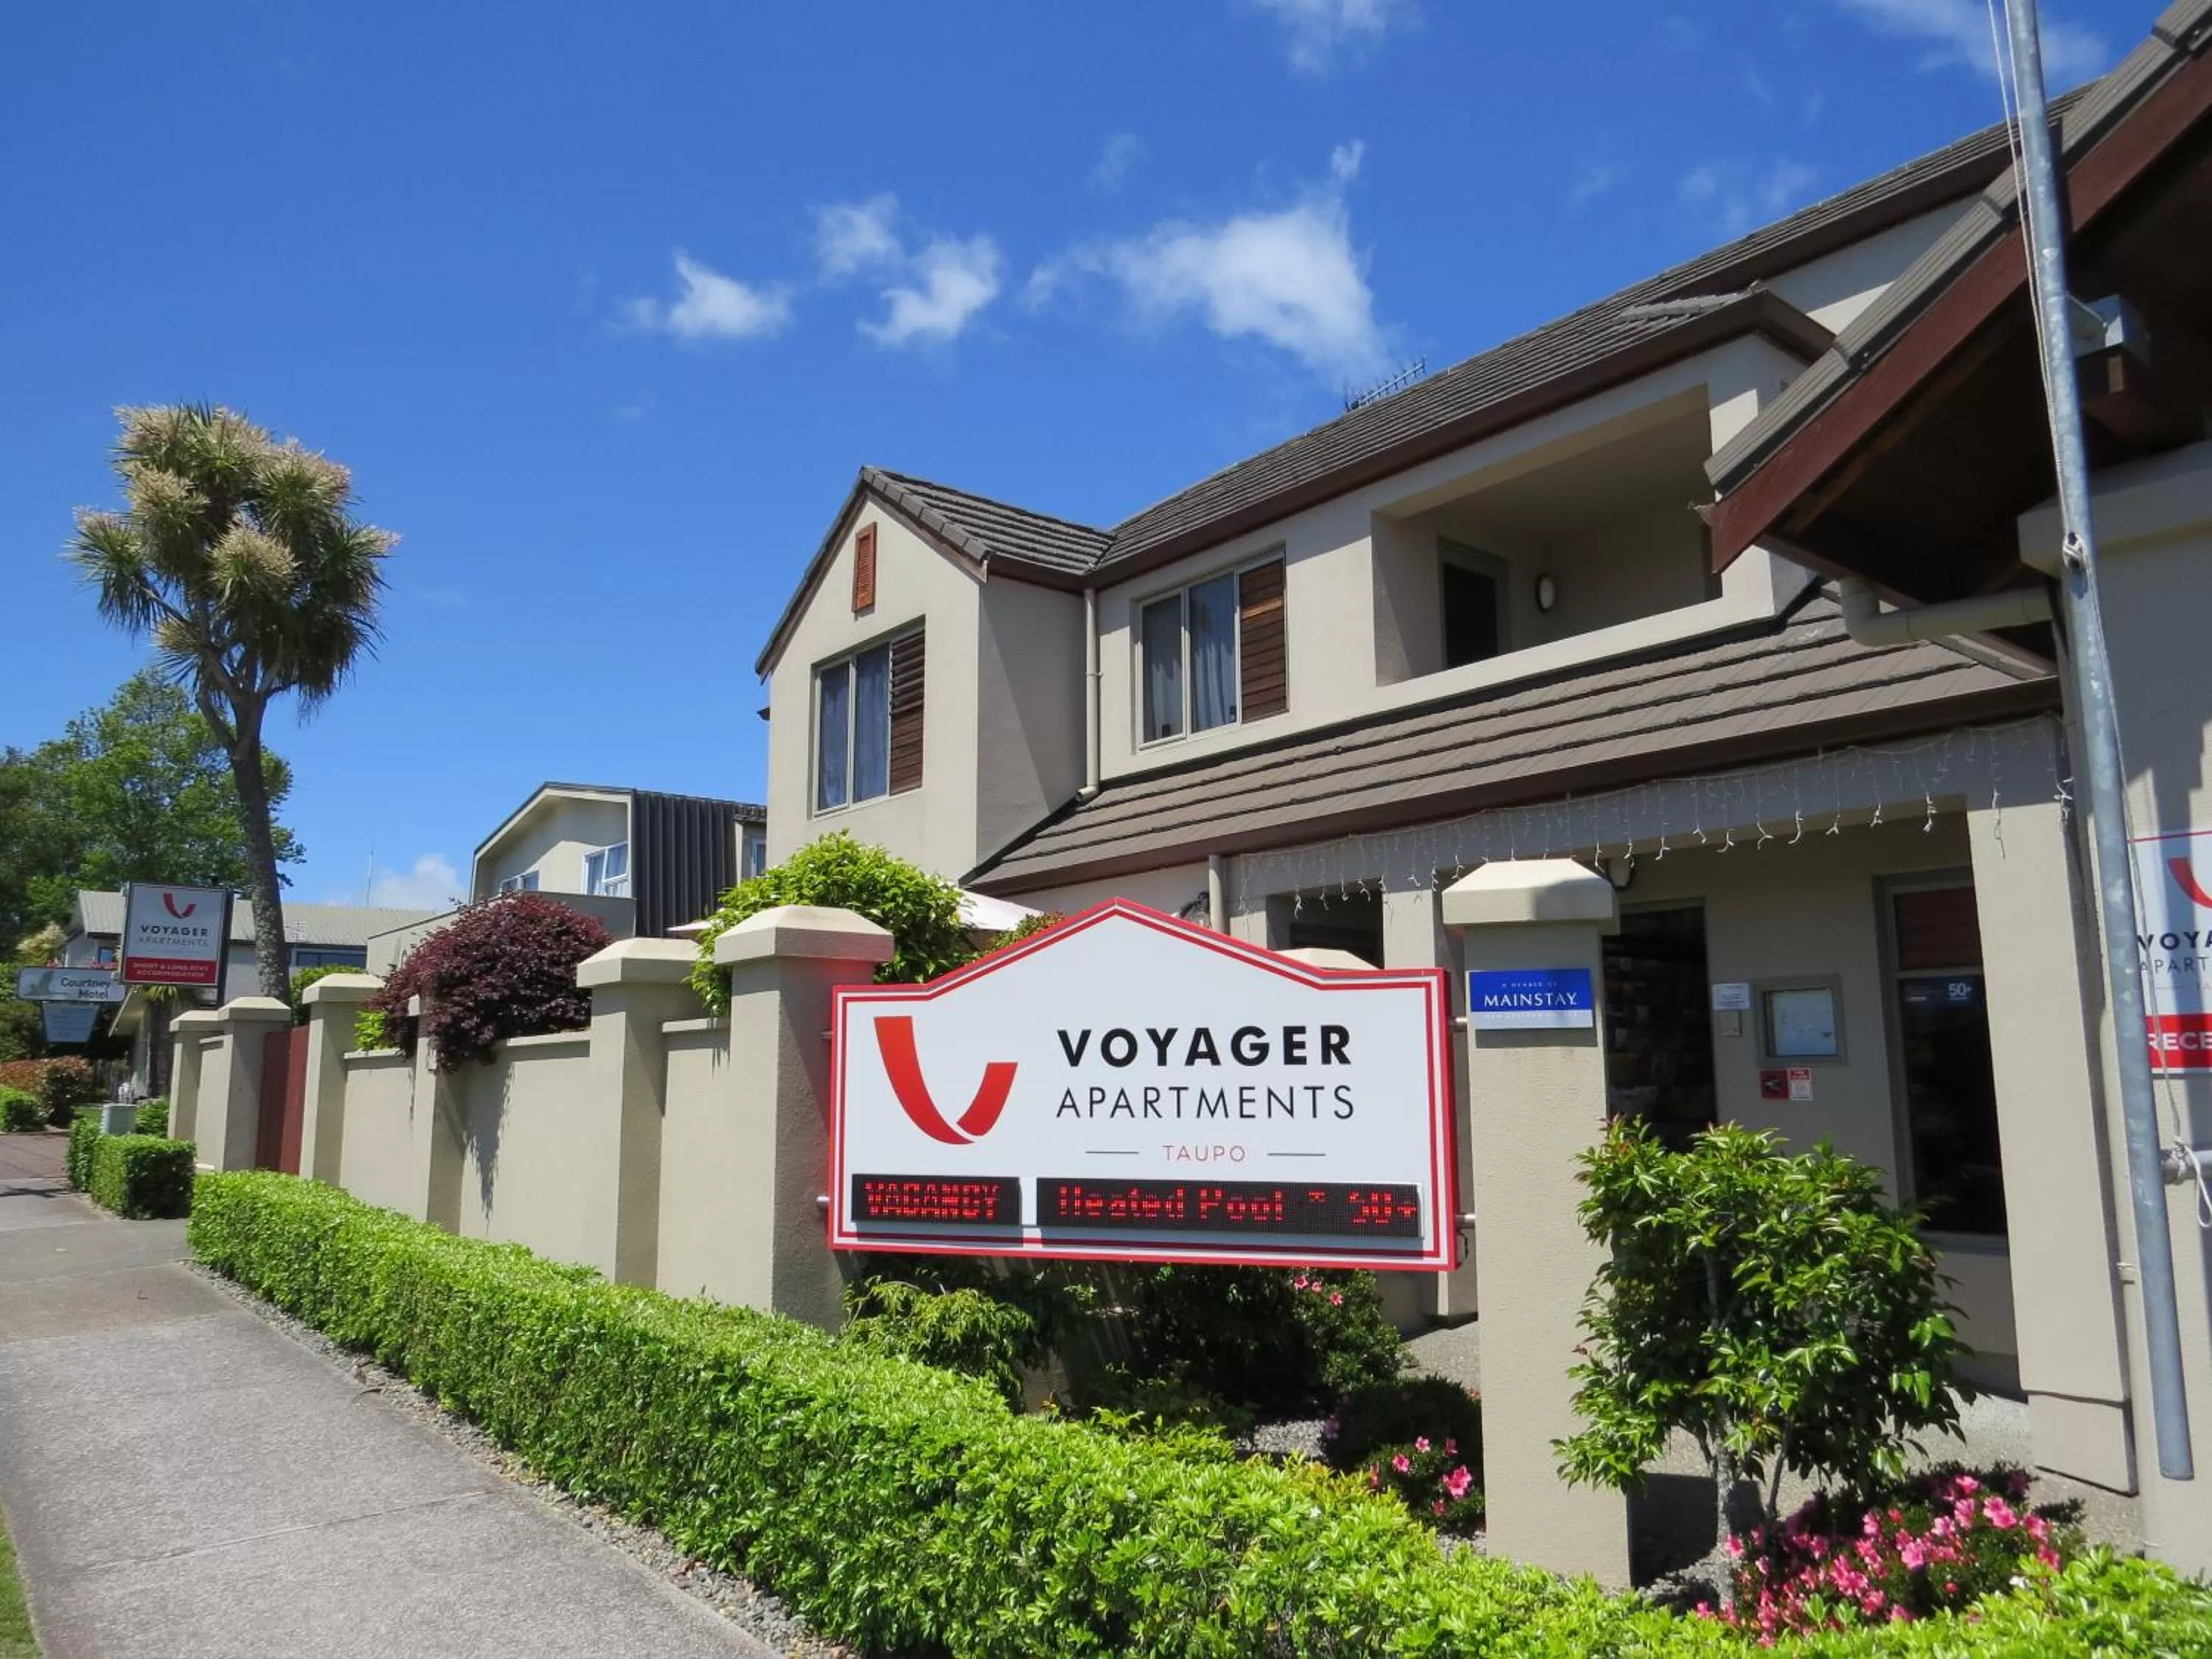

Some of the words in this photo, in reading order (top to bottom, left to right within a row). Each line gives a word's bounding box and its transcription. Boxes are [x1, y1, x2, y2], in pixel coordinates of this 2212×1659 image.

[140, 925, 208, 936] VOYAGER
[60, 977, 110, 988] Courtney
[78, 989, 108, 998] Motel
[1484, 992, 1578, 1007] MAINSTAY
[1057, 1025, 1351, 1068] VOYAGER
[1057, 1085, 1354, 1119] APARTMENTS
[1163, 1145, 1245, 1163] TAUPO
[1060, 1186, 1184, 1217] Heated
[1199, 1186, 1283, 1222] Pool
